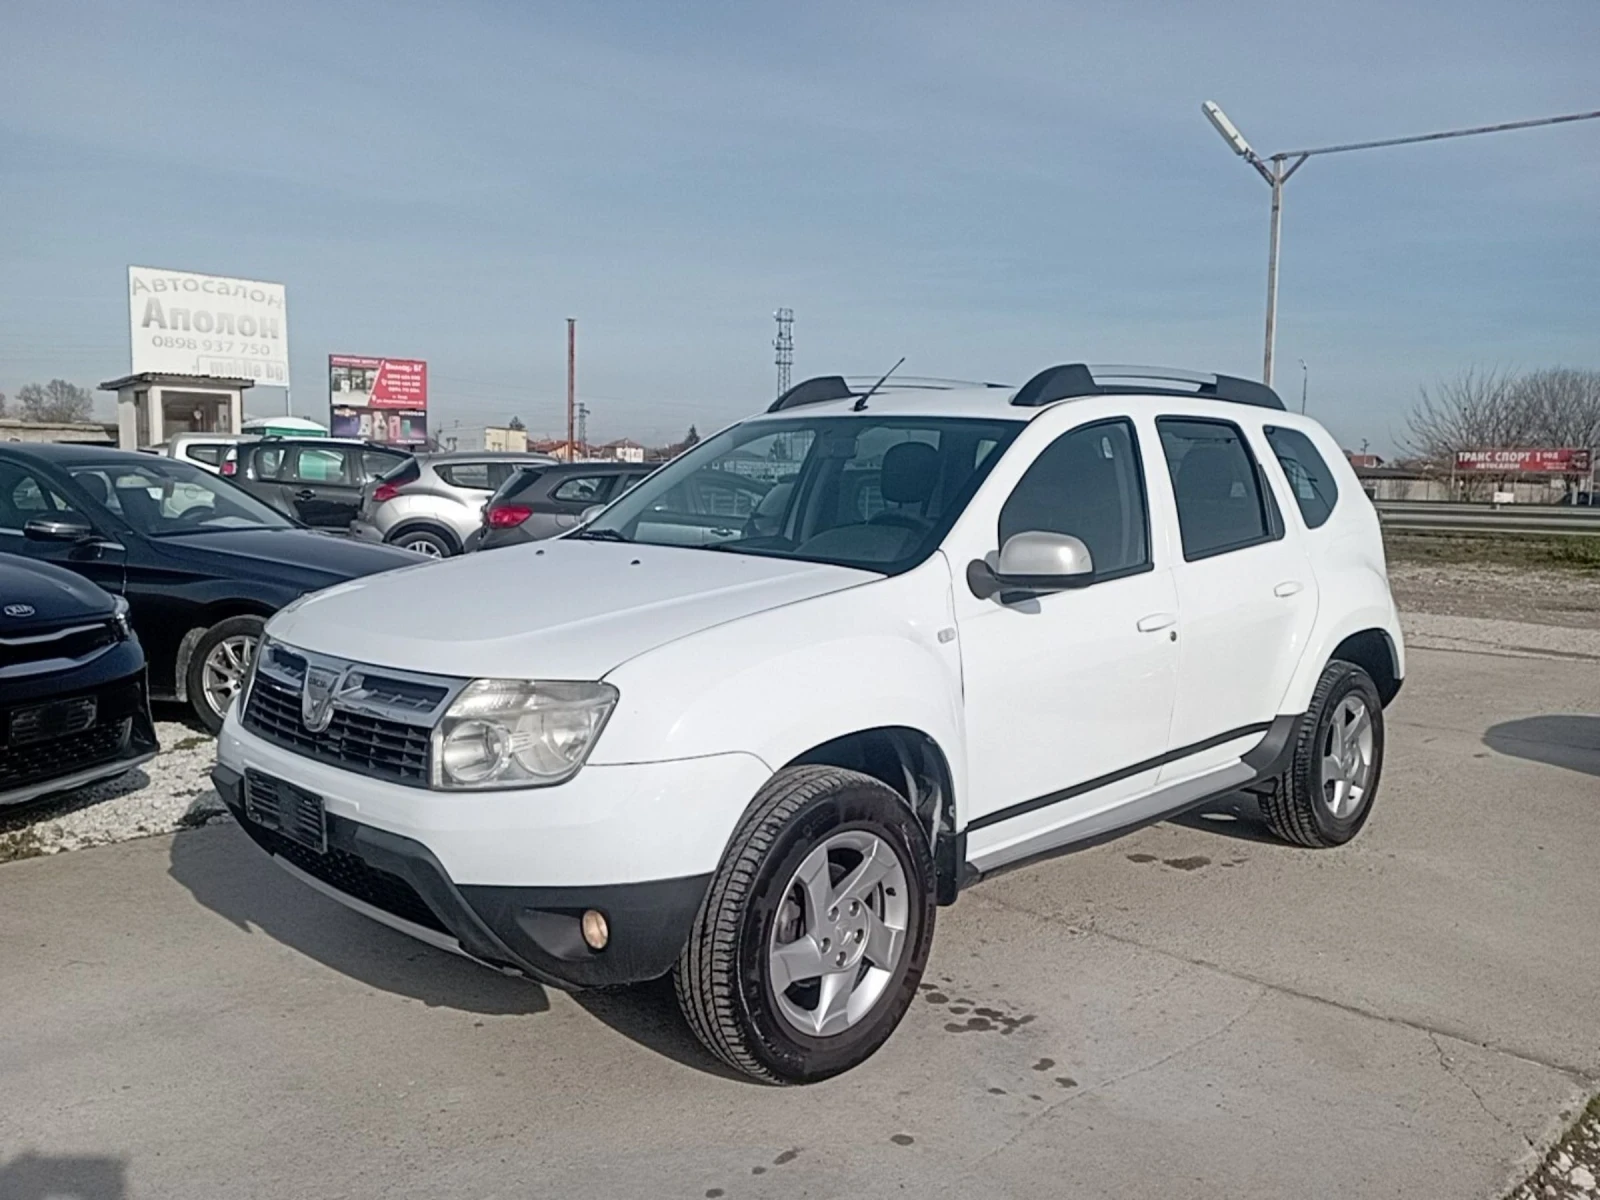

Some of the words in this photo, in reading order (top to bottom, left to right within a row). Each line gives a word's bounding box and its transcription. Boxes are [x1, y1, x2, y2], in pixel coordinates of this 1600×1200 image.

[142, 298, 279, 339] Аполон
[152, 335, 198, 350] 0898
[202, 340, 235, 353] 937
[240, 342, 271, 356] 750
[1458, 452, 1491, 462] ТРАНС
[1495, 452, 1531, 462] СПОРТ
